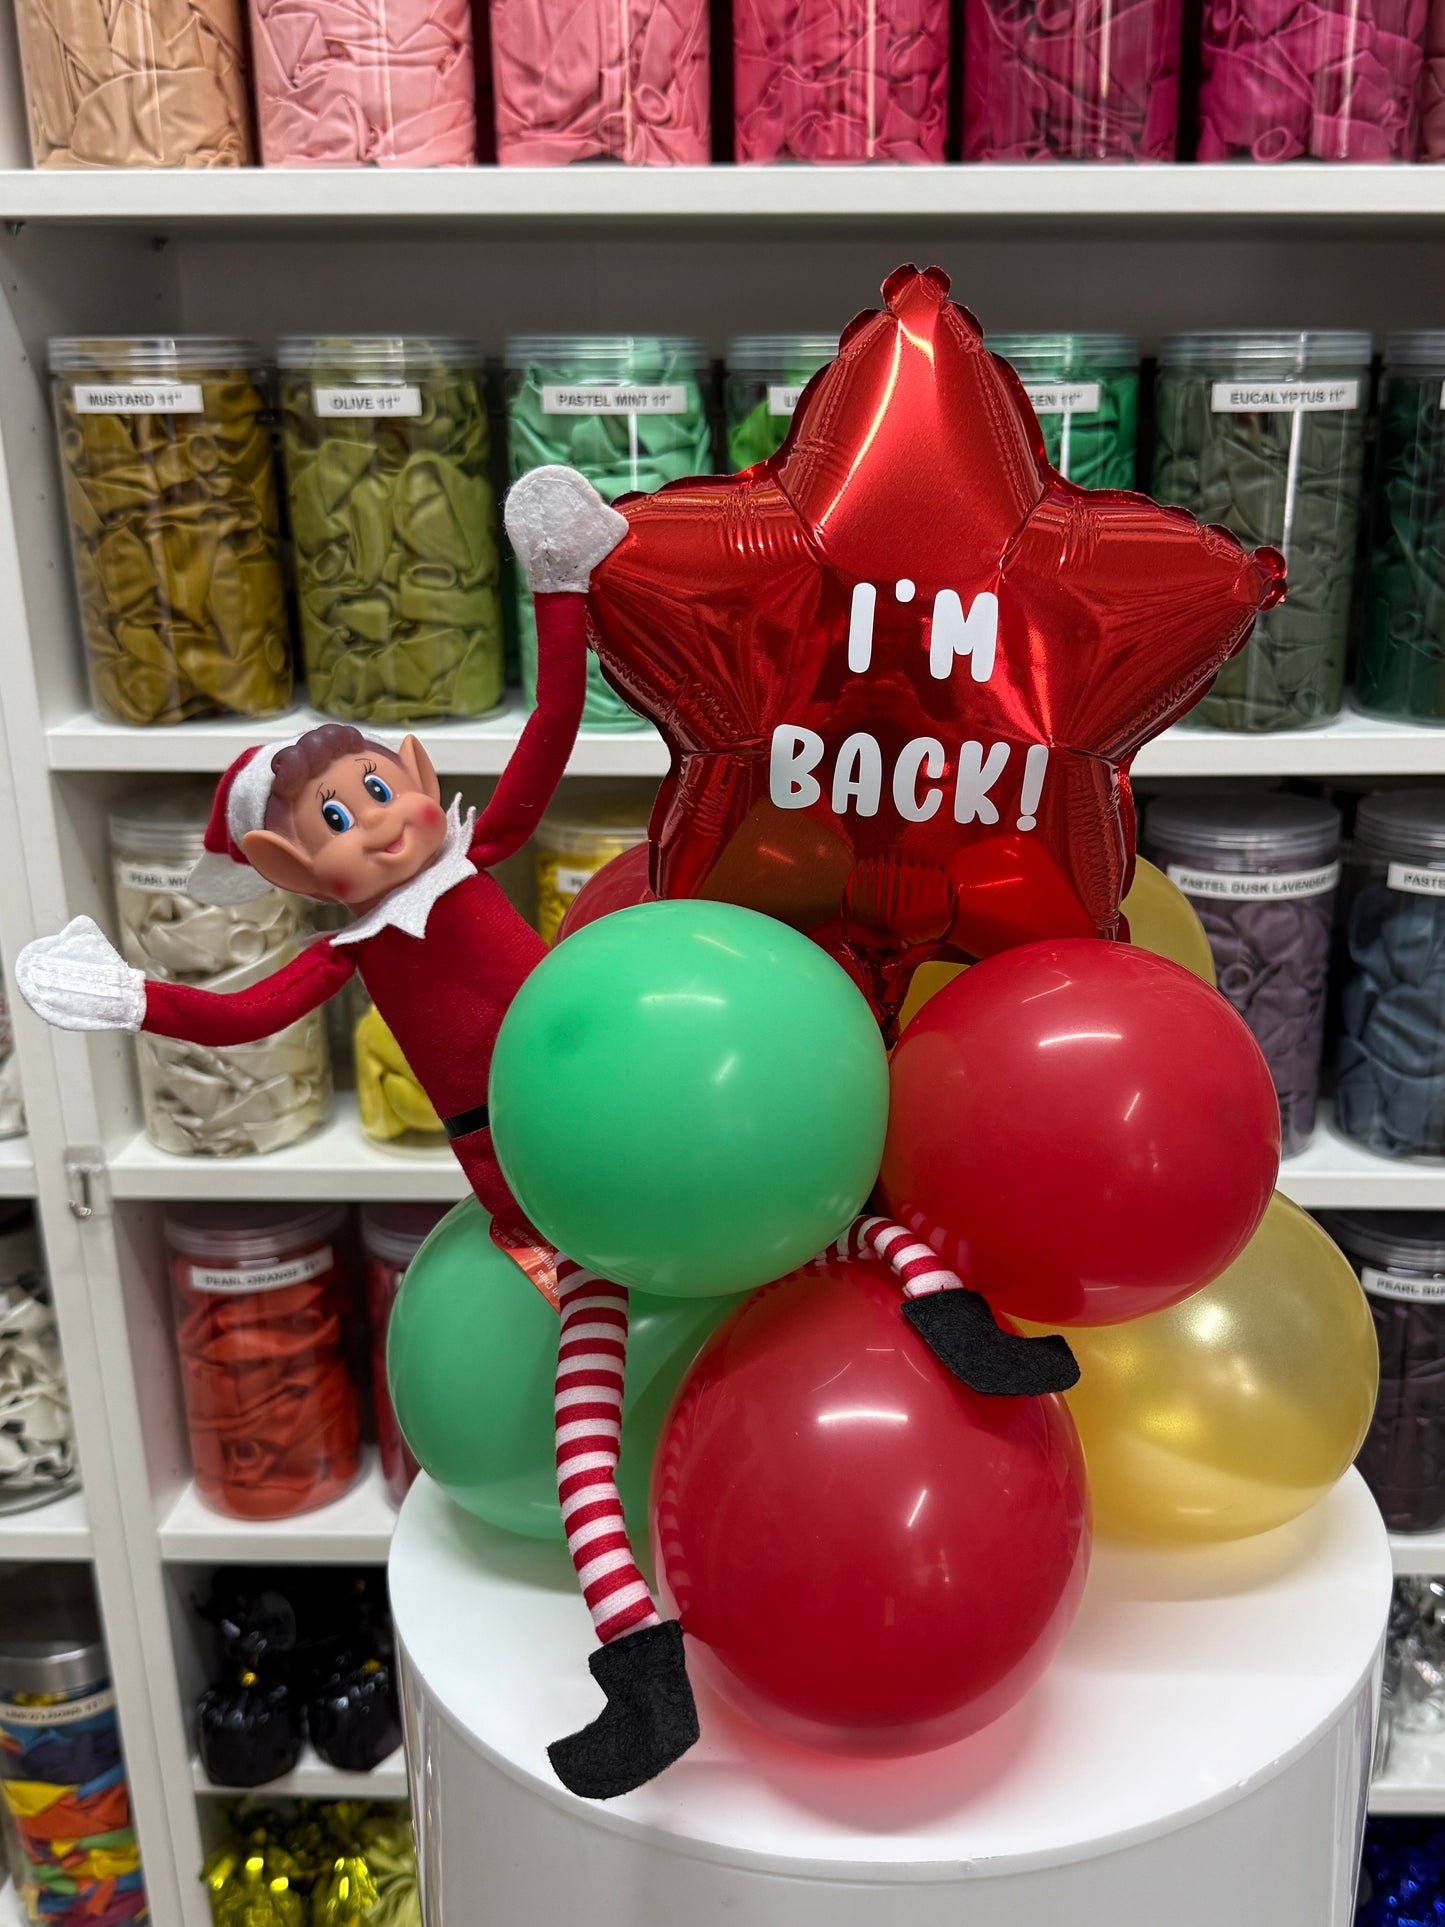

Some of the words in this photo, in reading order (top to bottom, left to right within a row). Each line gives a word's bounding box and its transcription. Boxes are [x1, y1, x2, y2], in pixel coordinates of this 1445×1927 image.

[87, 391, 155, 406] MUSTARD
[158, 391, 182, 406] 11"
[332, 397, 374, 410] OLIVE
[376, 396, 401, 410] 11"
[557, 394, 611, 407] PASTEL
[614, 394, 648, 407] MINT
[1230, 389, 1325, 405] EUCALYPTUS
[848, 579, 999, 682] I'M
[769, 724, 1049, 831] BACK!
[1179, 876, 1226, 893] PASTEL
[1231, 880, 1269, 894] DUSK
